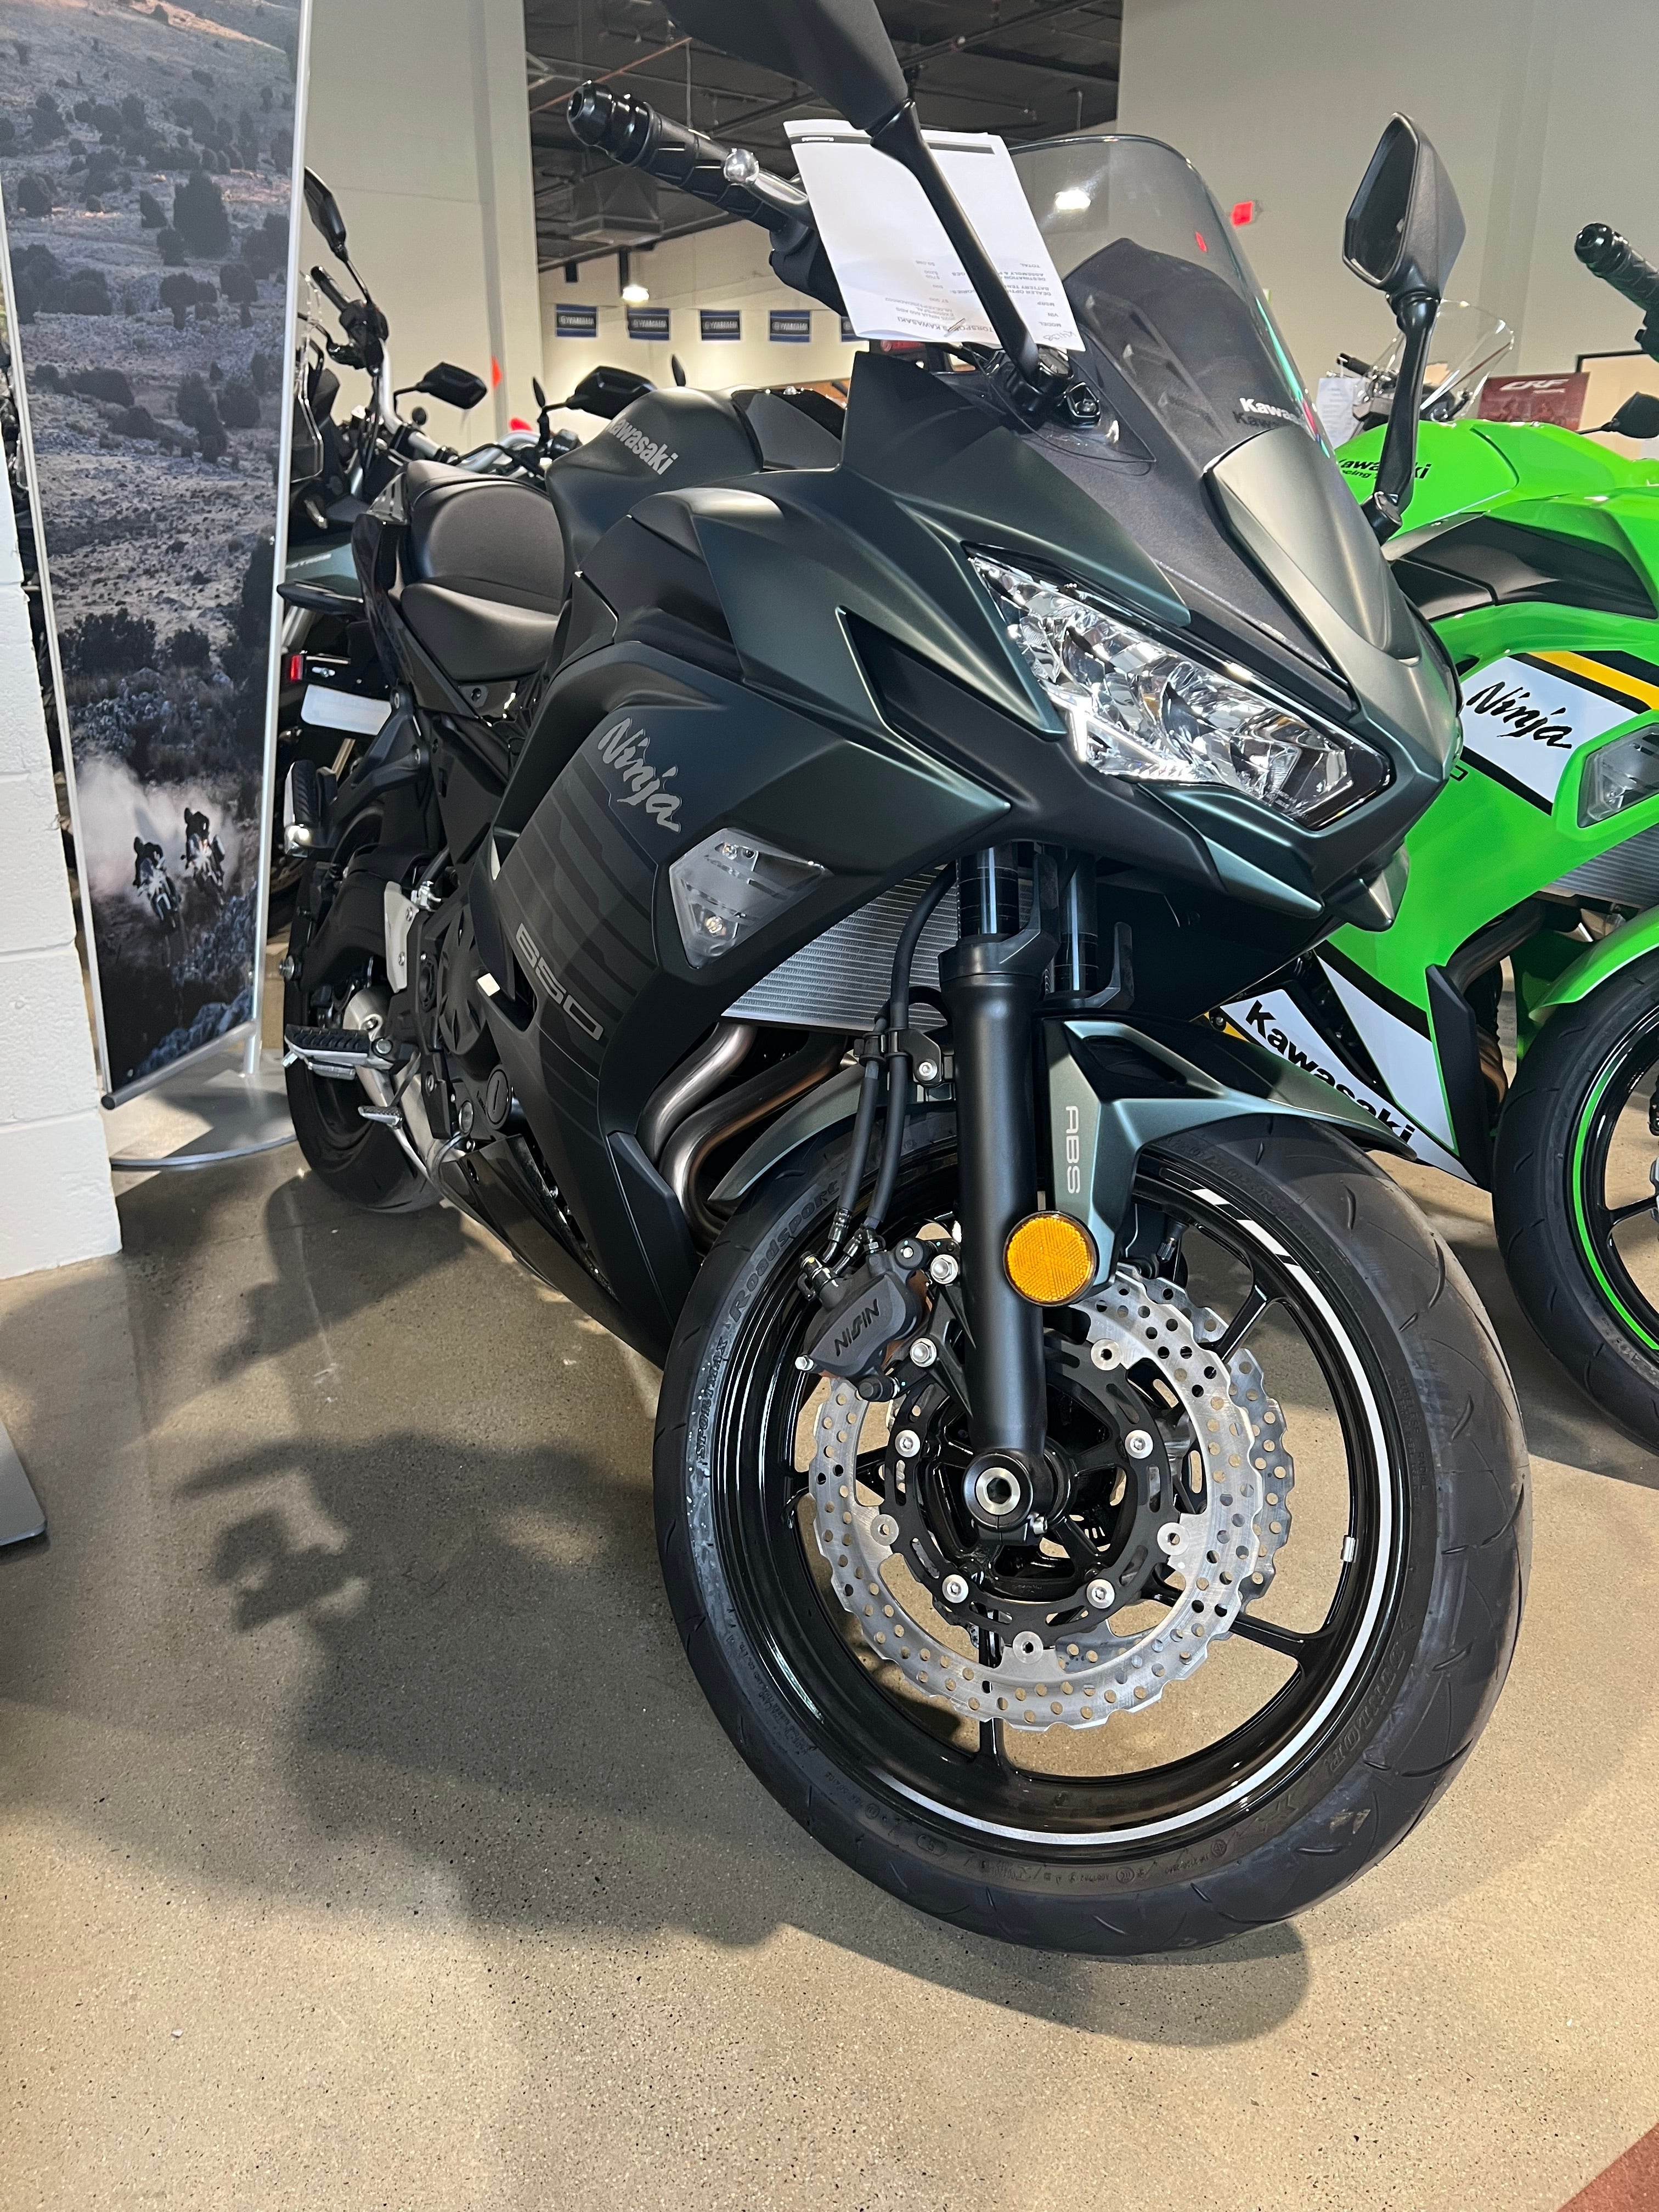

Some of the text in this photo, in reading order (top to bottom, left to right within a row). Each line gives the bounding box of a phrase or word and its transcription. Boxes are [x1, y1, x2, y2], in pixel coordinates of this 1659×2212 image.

[897, 316, 940, 330] KAWASAKI
[1499, 379, 1570, 391] CRF
[608, 419, 679, 475] awasaki
[1466, 681, 1572, 749] Ninja
[598, 718, 682, 833] Ninja
[516, 923, 604, 1041] 650
[1065, 1105, 1081, 1194] ABS
[730, 1178, 840, 1323] Roadsport
